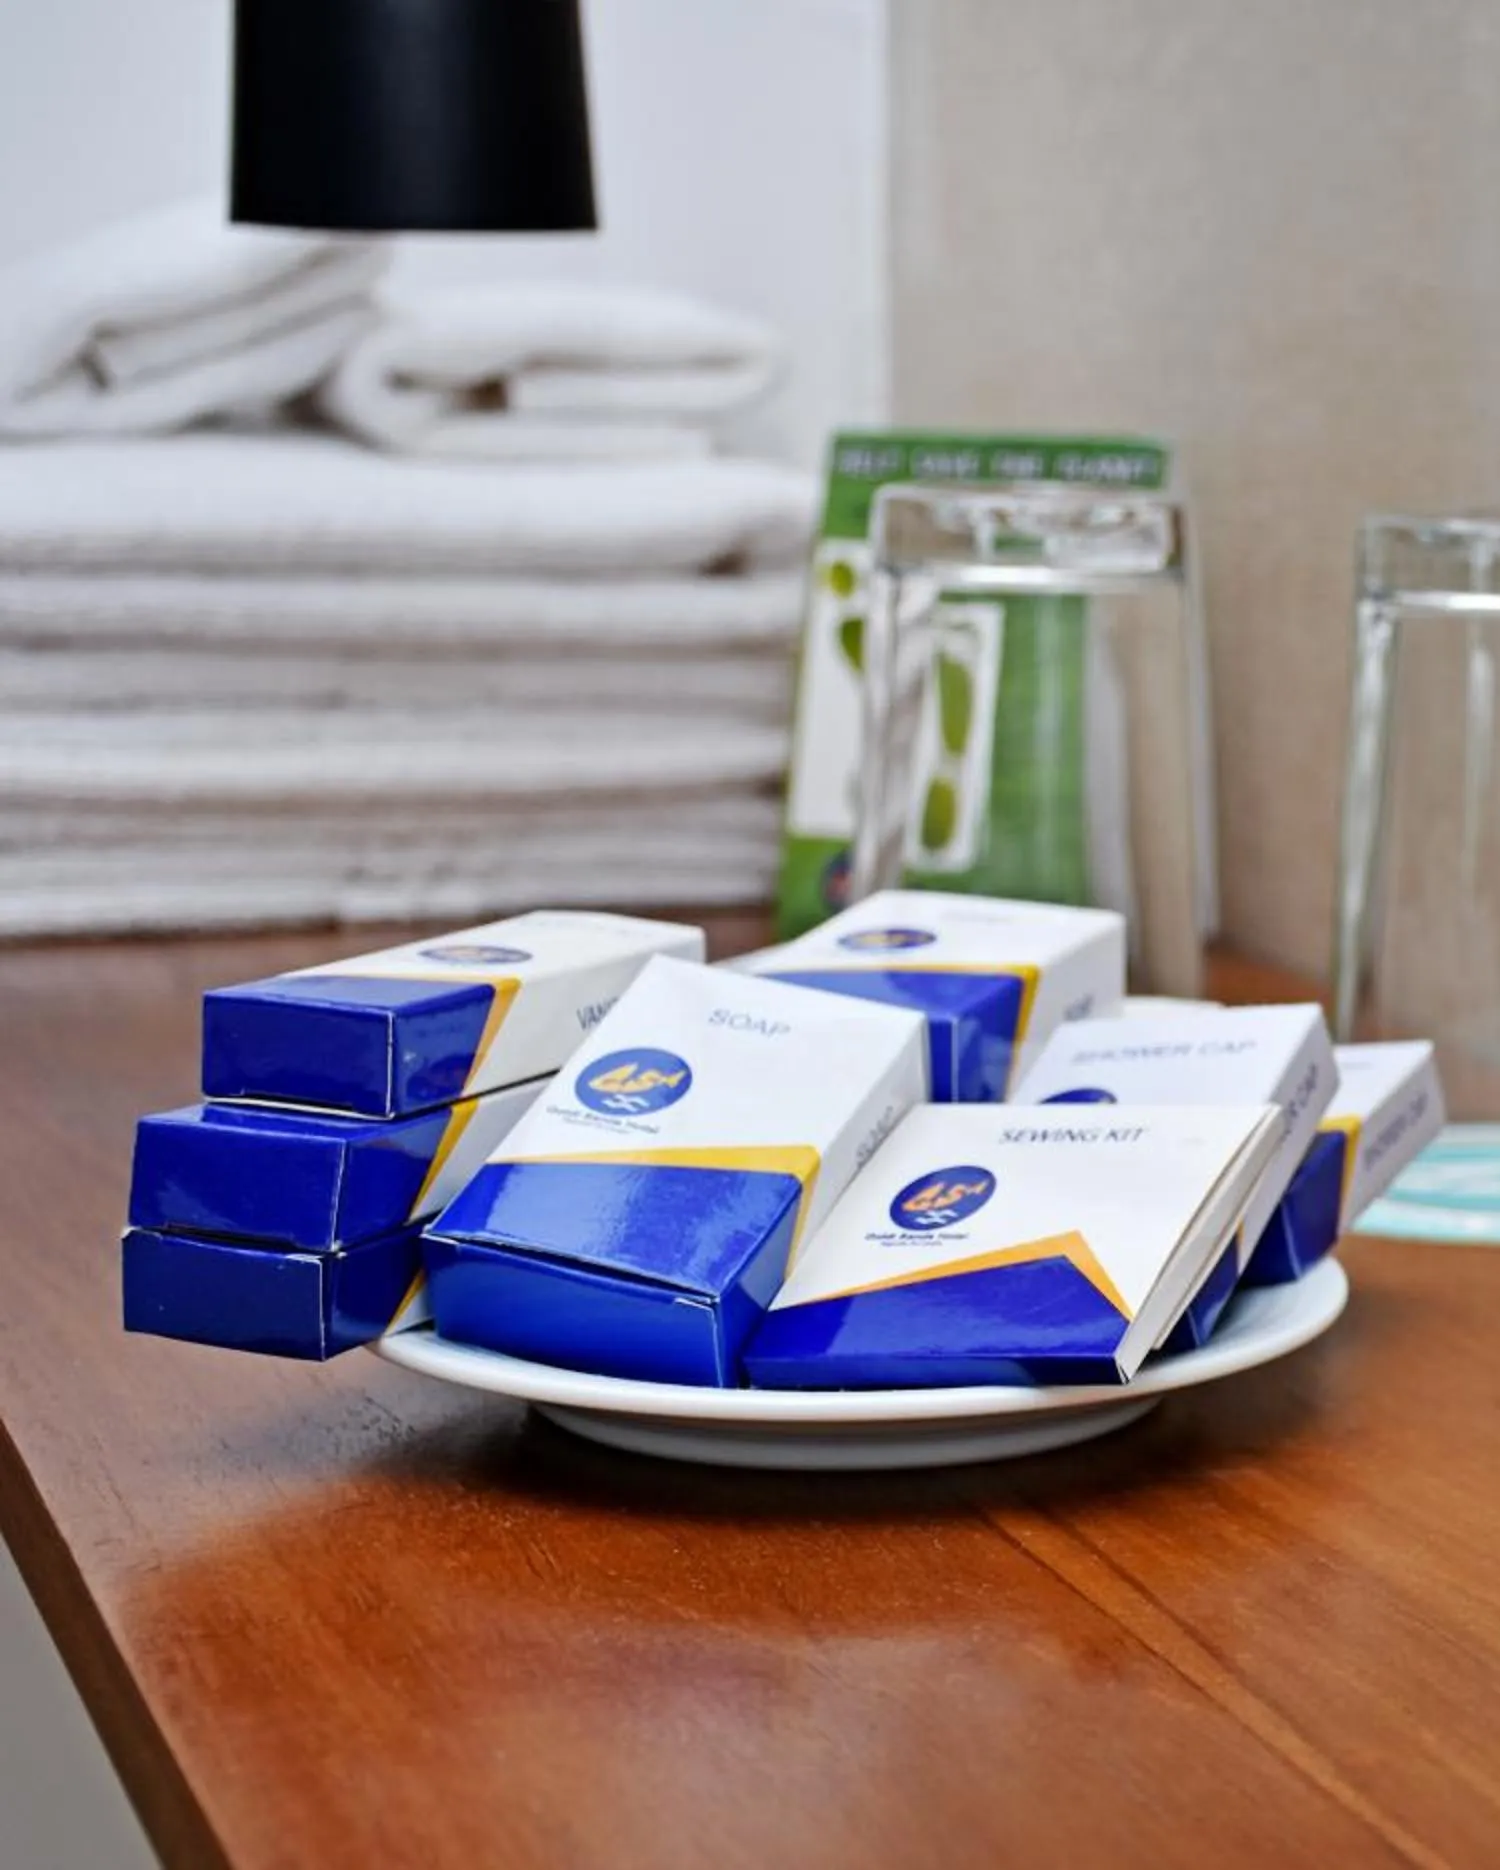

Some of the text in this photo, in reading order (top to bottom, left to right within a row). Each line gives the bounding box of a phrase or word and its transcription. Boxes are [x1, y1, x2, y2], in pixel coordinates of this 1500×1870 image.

[707, 1007, 792, 1039] SOAP
[999, 1126, 1147, 1144] SEWING KIT
